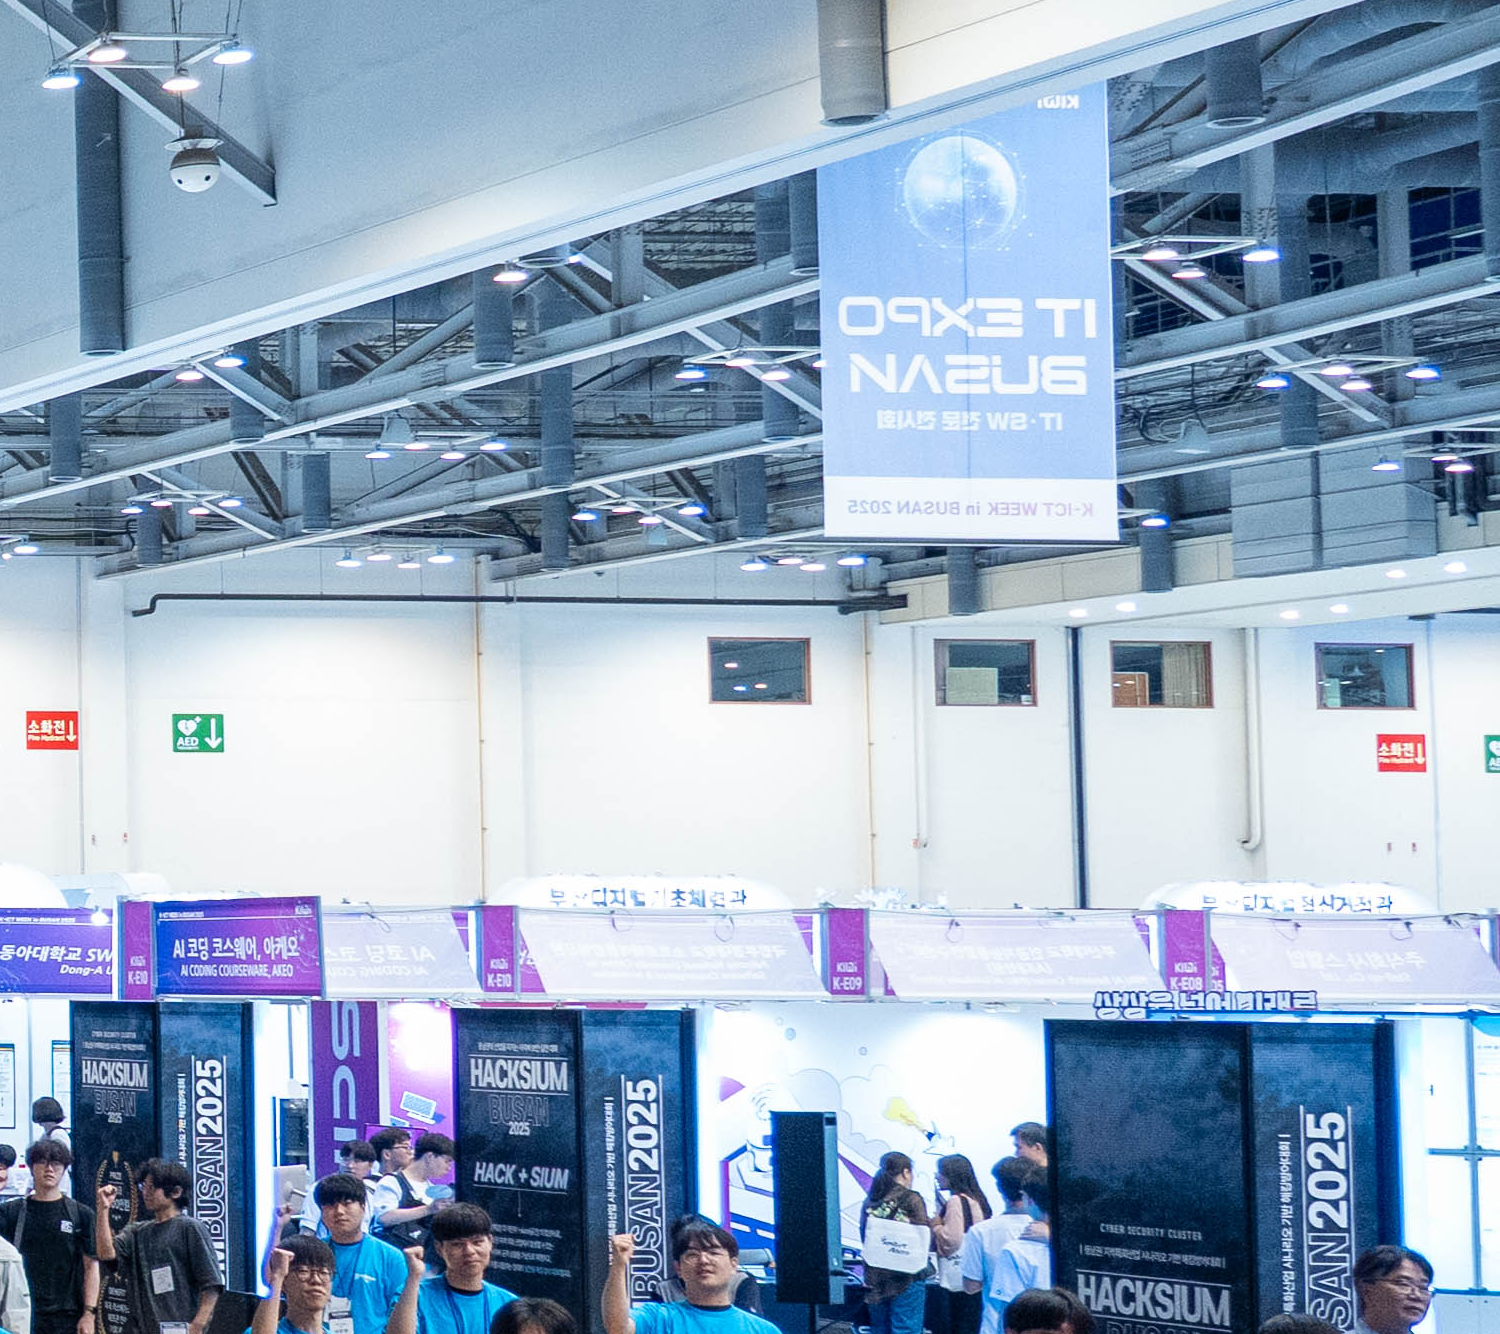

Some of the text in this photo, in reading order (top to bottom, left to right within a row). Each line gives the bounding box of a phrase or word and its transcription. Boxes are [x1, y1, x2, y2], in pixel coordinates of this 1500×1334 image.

[28, 720, 65, 734] 소화전
[177, 737, 198, 746] AED
[0, 944, 82, 962] 동아대학교
[173, 936, 300, 961] AI 코딩 코스웨어, 아케오
[60, 964, 102, 975] Dong-A
[189, 965, 217, 976] CODING
[272, 964, 293, 977] AKEO
[487, 973, 512, 988] K-E10
[832, 975, 862, 991] K-E09
[1170, 977, 1202, 991] K-E08
[81, 1059, 149, 1088] HACKSIUM
[469, 1058, 568, 1092] HACKSIUM
[489, 1094, 549, 1127] BUSAN
[508, 1121, 530, 1136] 2025
[474, 1161, 569, 1190] HACK SIUM
[1278, 1141, 1294, 1268] 시나리오 기반 해킹방어대회
[1100, 1223, 1203, 1241] CYBER SECURITY CLUSTER
[1077, 1273, 1231, 1327] HACKSIUM
